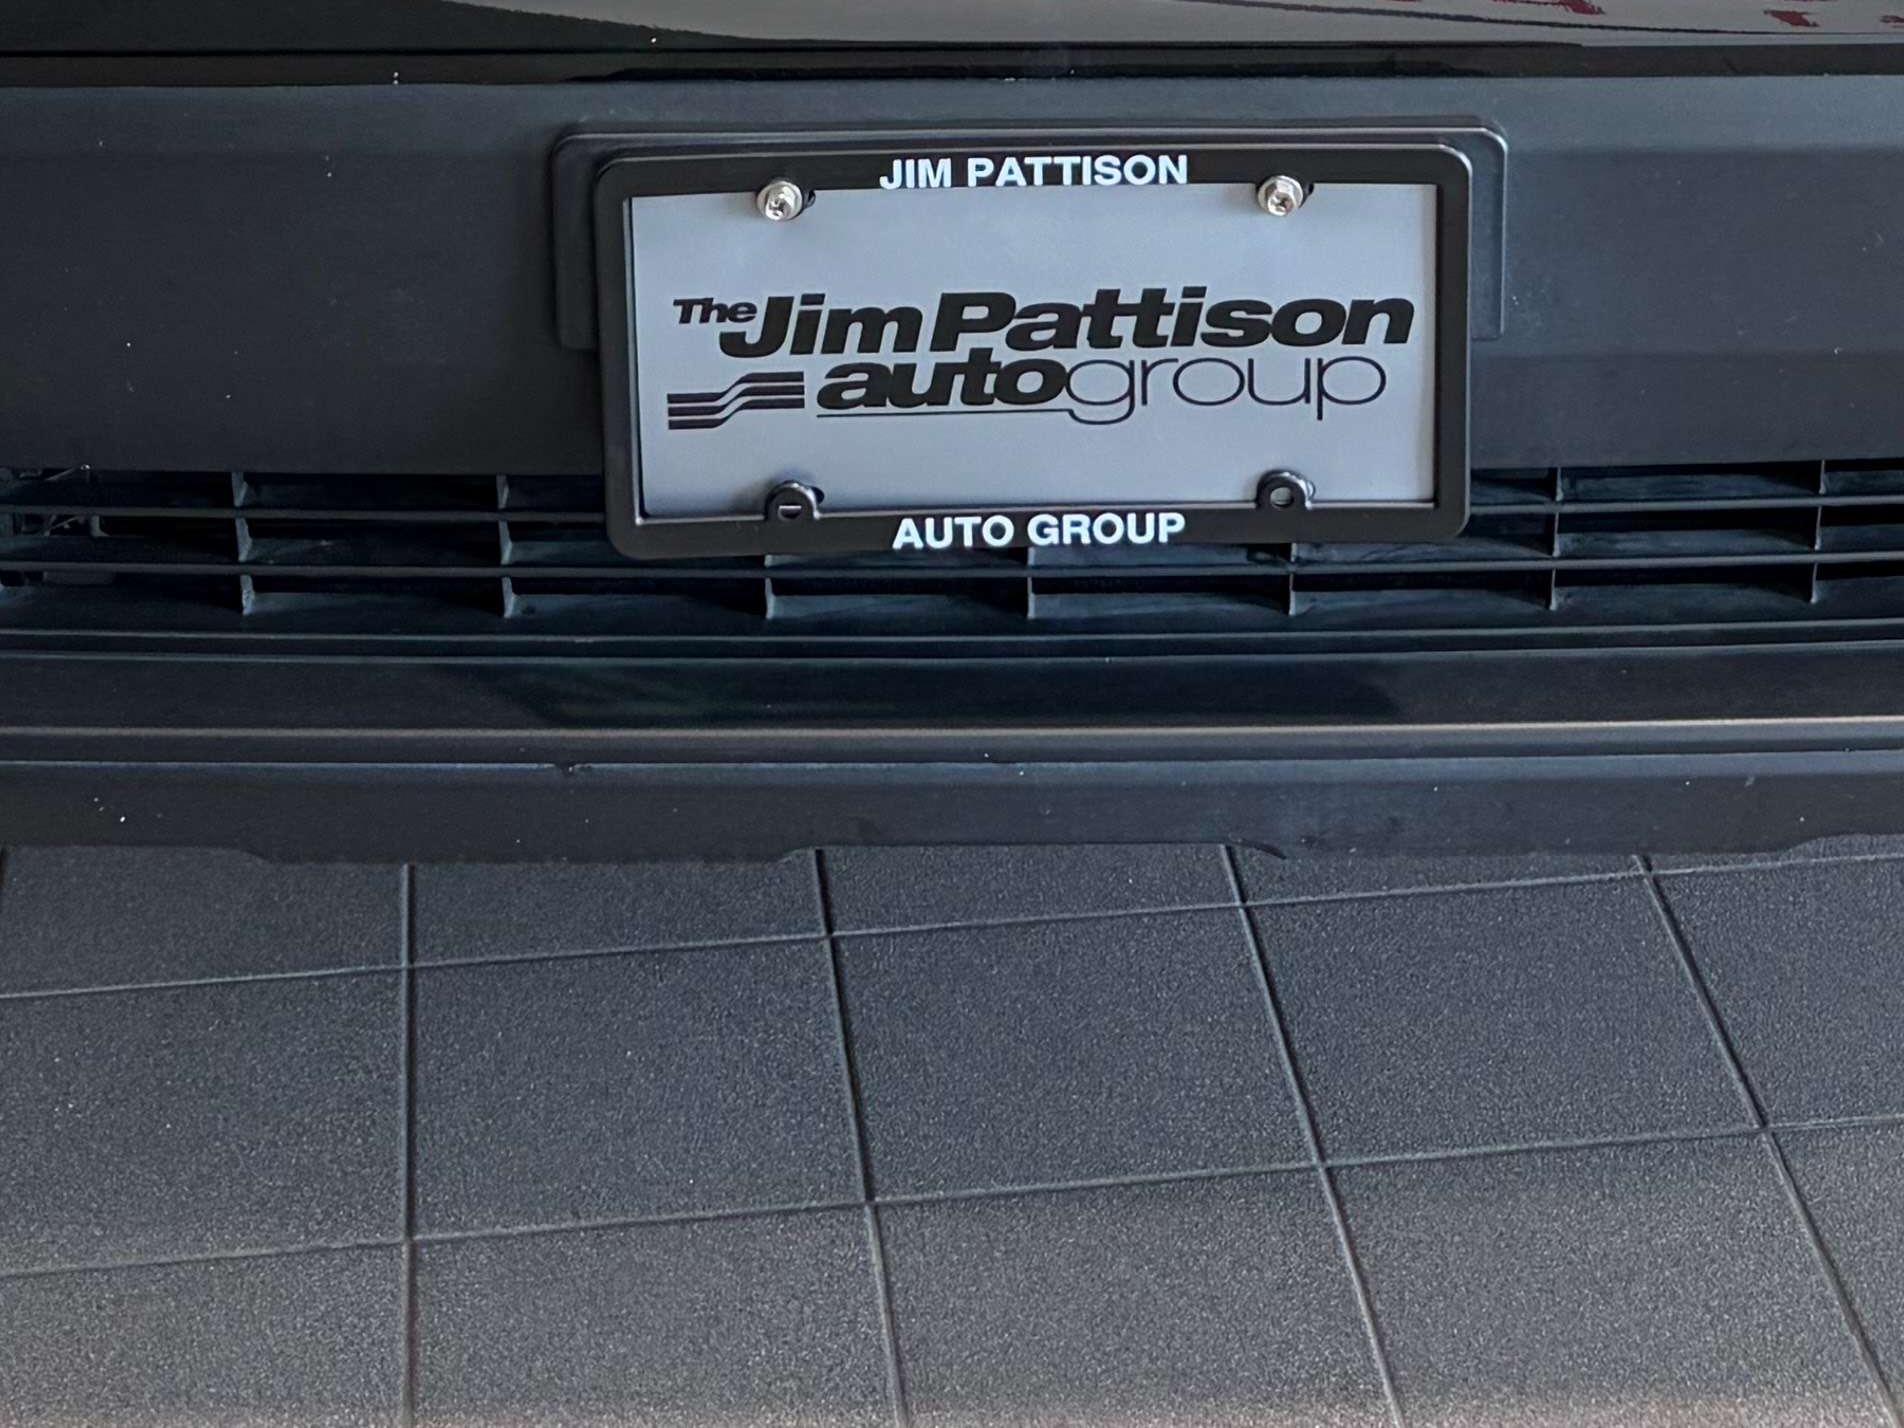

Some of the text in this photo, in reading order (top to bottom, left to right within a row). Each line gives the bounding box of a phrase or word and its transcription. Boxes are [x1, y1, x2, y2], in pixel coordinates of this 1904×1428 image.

[879, 154, 1188, 190] JIM PATTISON
[673, 286, 1415, 358] The Jim Pattison
[892, 512, 1185, 550] AUTO GROUP
